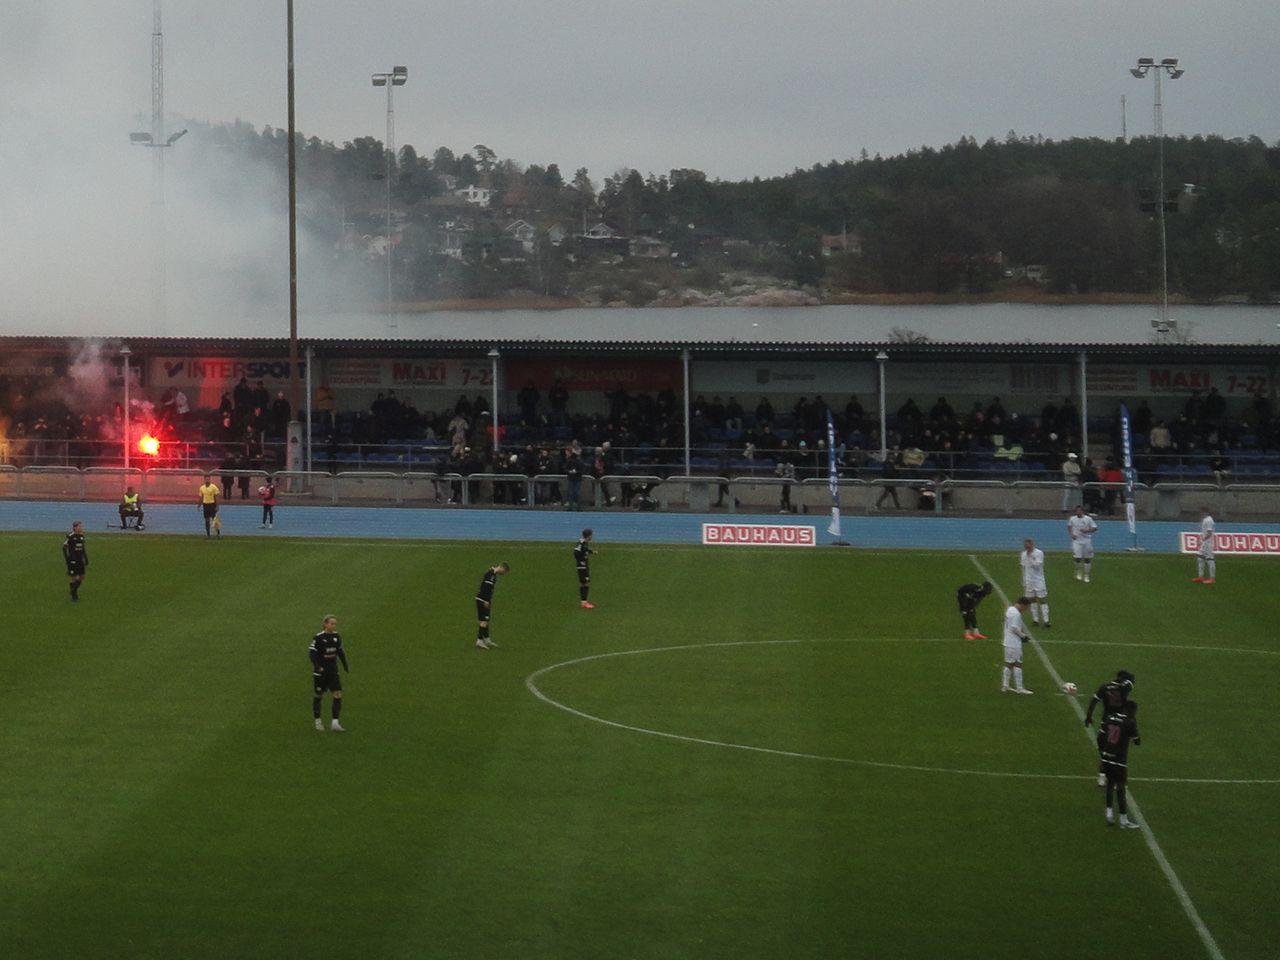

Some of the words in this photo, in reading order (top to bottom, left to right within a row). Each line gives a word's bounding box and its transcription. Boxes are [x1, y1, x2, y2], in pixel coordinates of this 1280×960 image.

[392, 363, 447, 380] MAXI
[1150, 368, 1211, 387] MAXI
[707, 527, 811, 542] BAUHAUS
[1185, 535, 1279, 550] BUHAU
